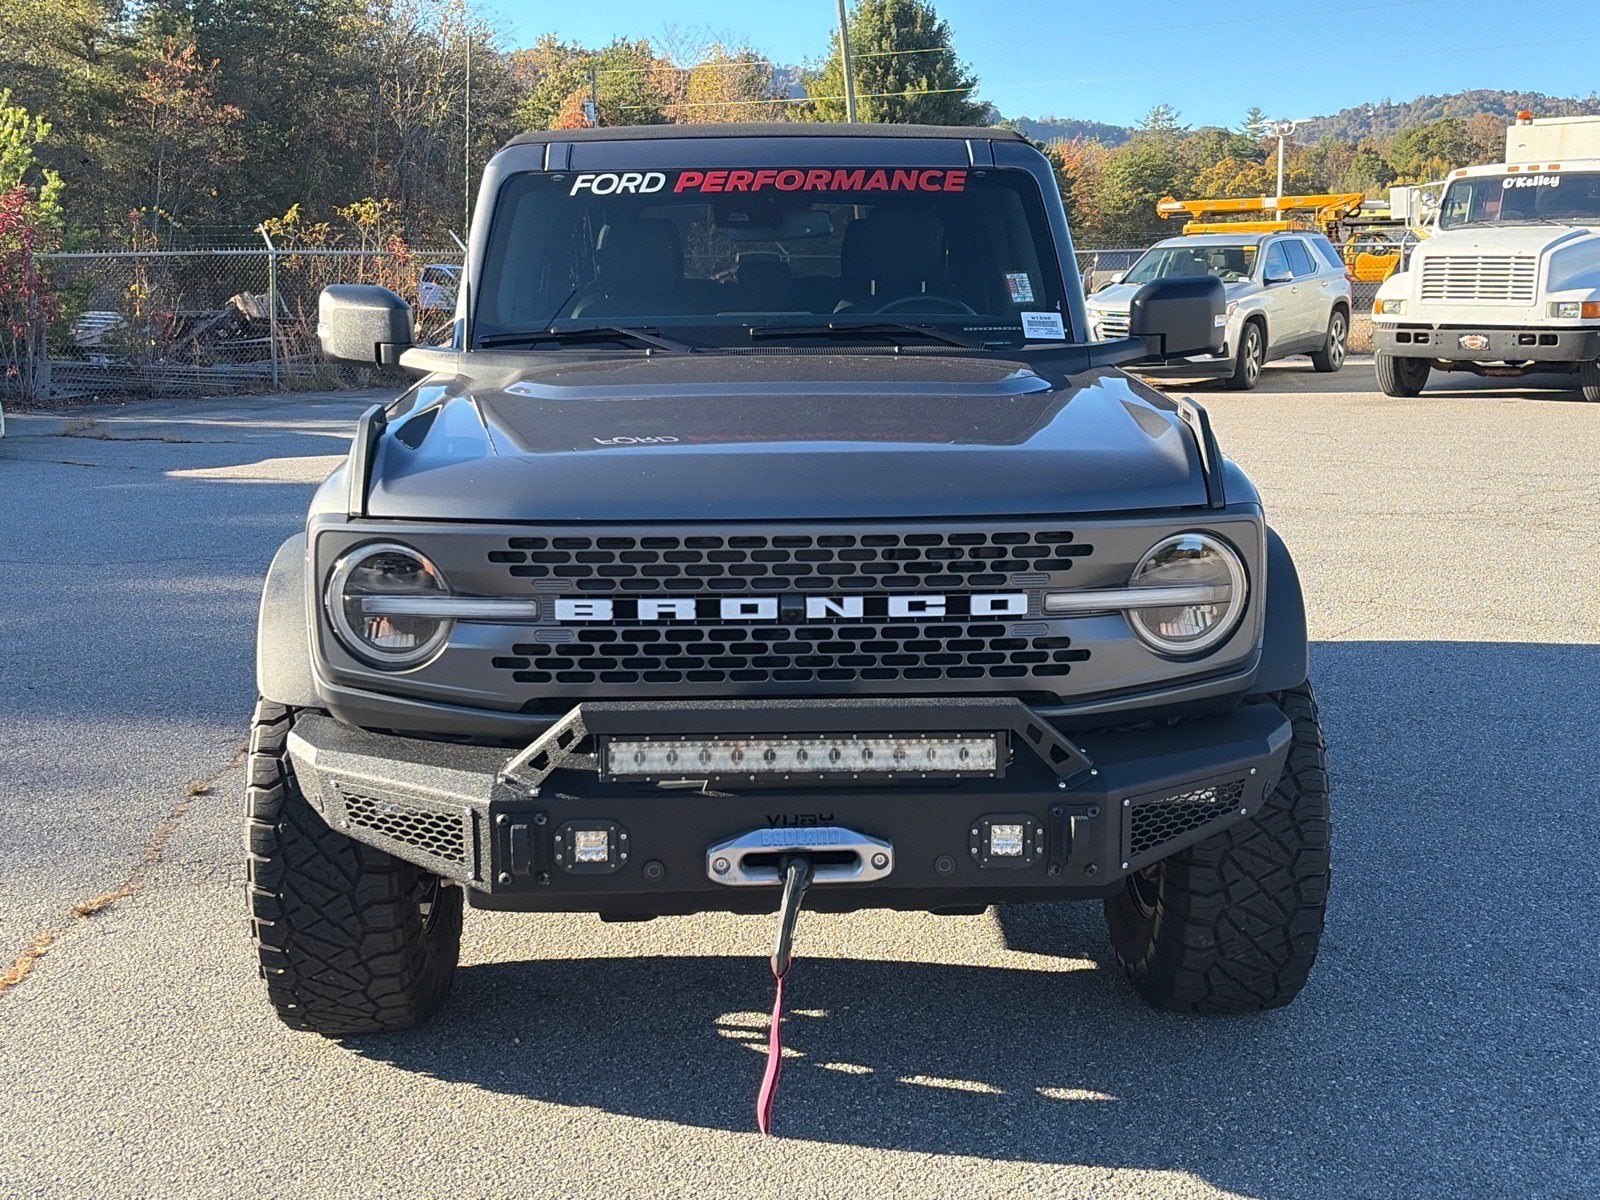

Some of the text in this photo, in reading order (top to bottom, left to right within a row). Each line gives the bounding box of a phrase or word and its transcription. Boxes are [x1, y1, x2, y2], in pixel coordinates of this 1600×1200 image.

[569, 169, 968, 197] FORD PERFORMANCE
[1502, 175, 1560, 189] O'Kelley
[554, 593, 1028, 621] BRONCO
